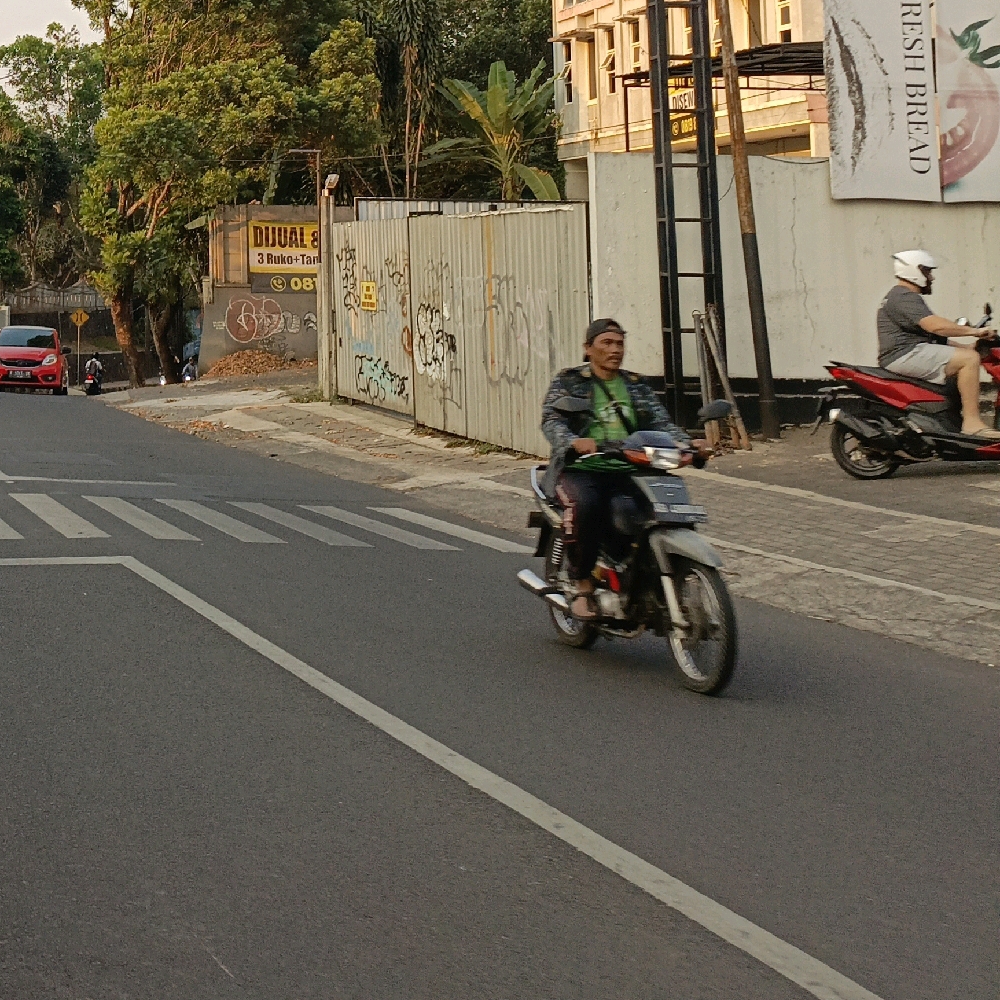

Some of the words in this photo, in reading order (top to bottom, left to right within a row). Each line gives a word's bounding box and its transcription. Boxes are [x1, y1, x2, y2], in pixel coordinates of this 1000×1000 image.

[905, 81, 932, 175] BREAD
[252, 226, 308, 249] DIJUAL
[257, 252, 264, 265] 3
